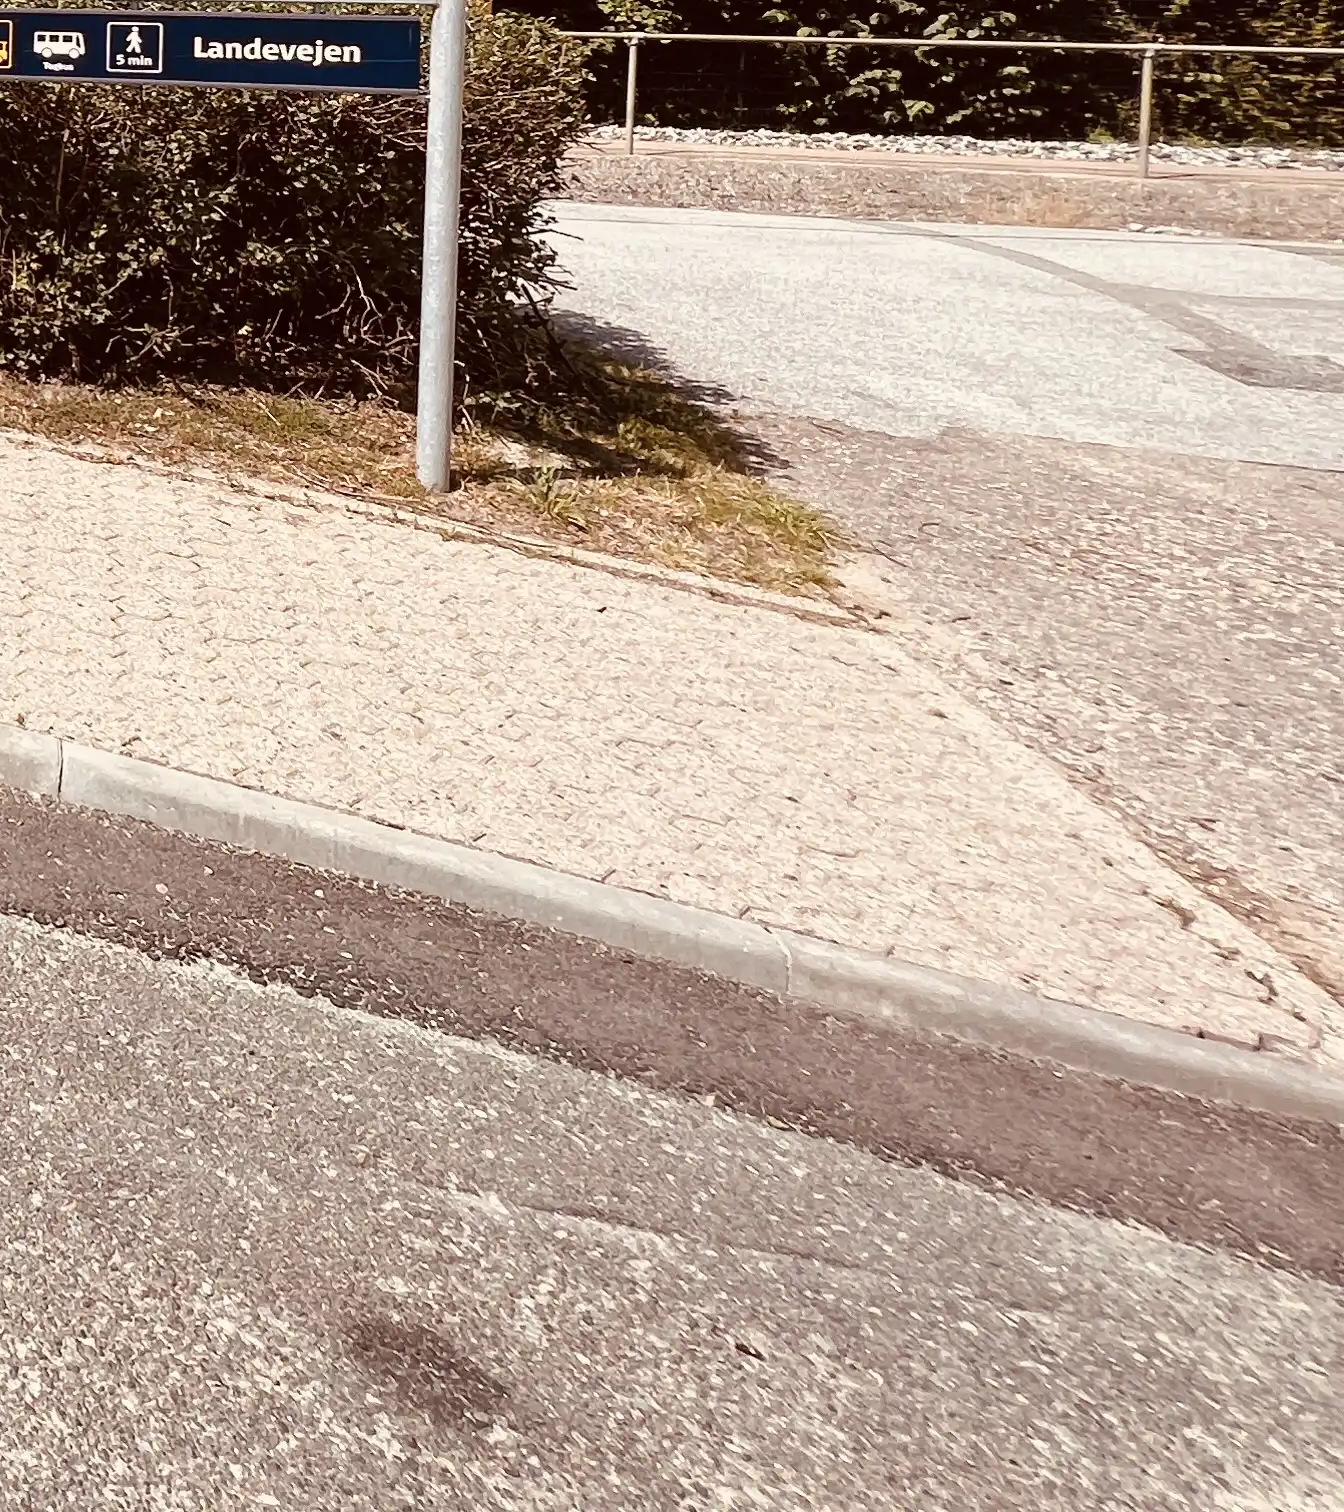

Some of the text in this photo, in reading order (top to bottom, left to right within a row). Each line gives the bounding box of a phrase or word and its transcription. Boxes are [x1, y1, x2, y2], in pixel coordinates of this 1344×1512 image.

[115, 53, 153, 66] 5 min
[193, 36, 362, 67] Landevejen
